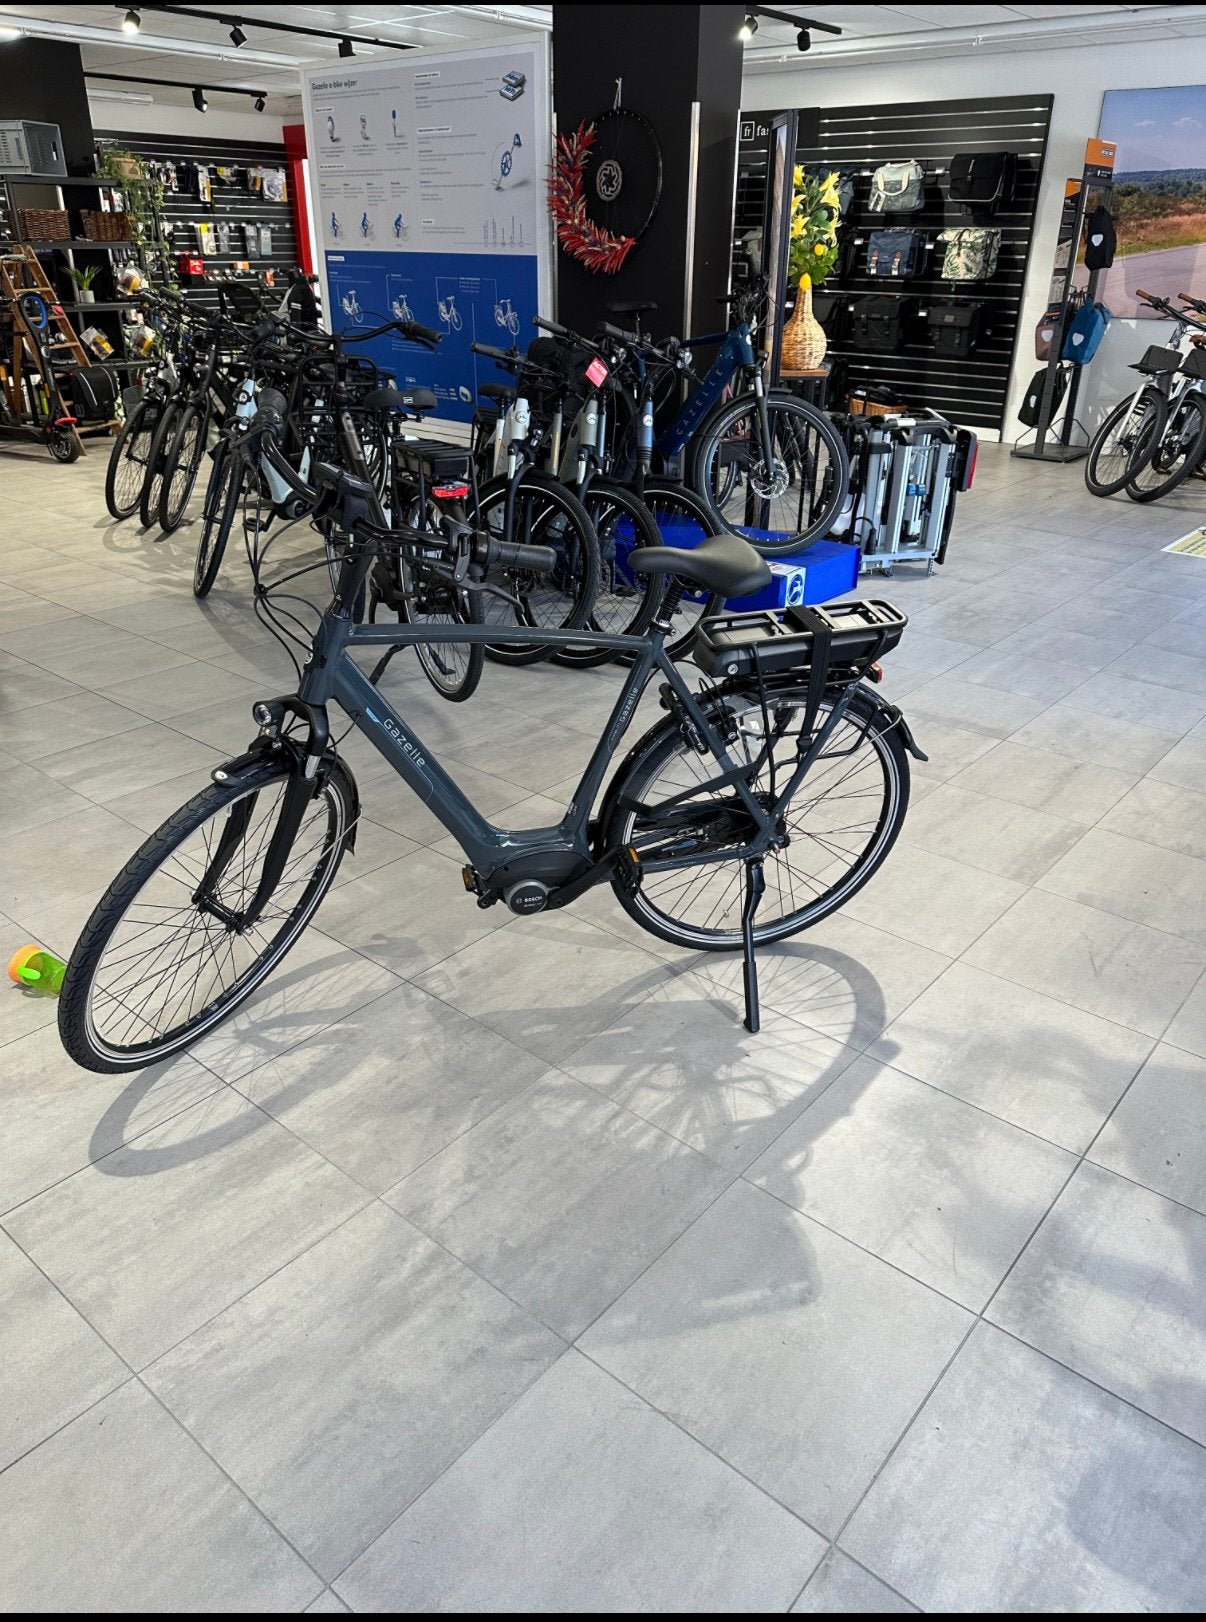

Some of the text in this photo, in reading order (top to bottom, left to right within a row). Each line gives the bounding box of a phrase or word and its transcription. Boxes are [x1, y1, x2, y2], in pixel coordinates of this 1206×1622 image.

[744, 126, 752, 137] fr
[676, 369, 723, 435] GAZELLE
[619, 687, 639, 722] Gazelle
[383, 718, 426, 767] Gazelle
